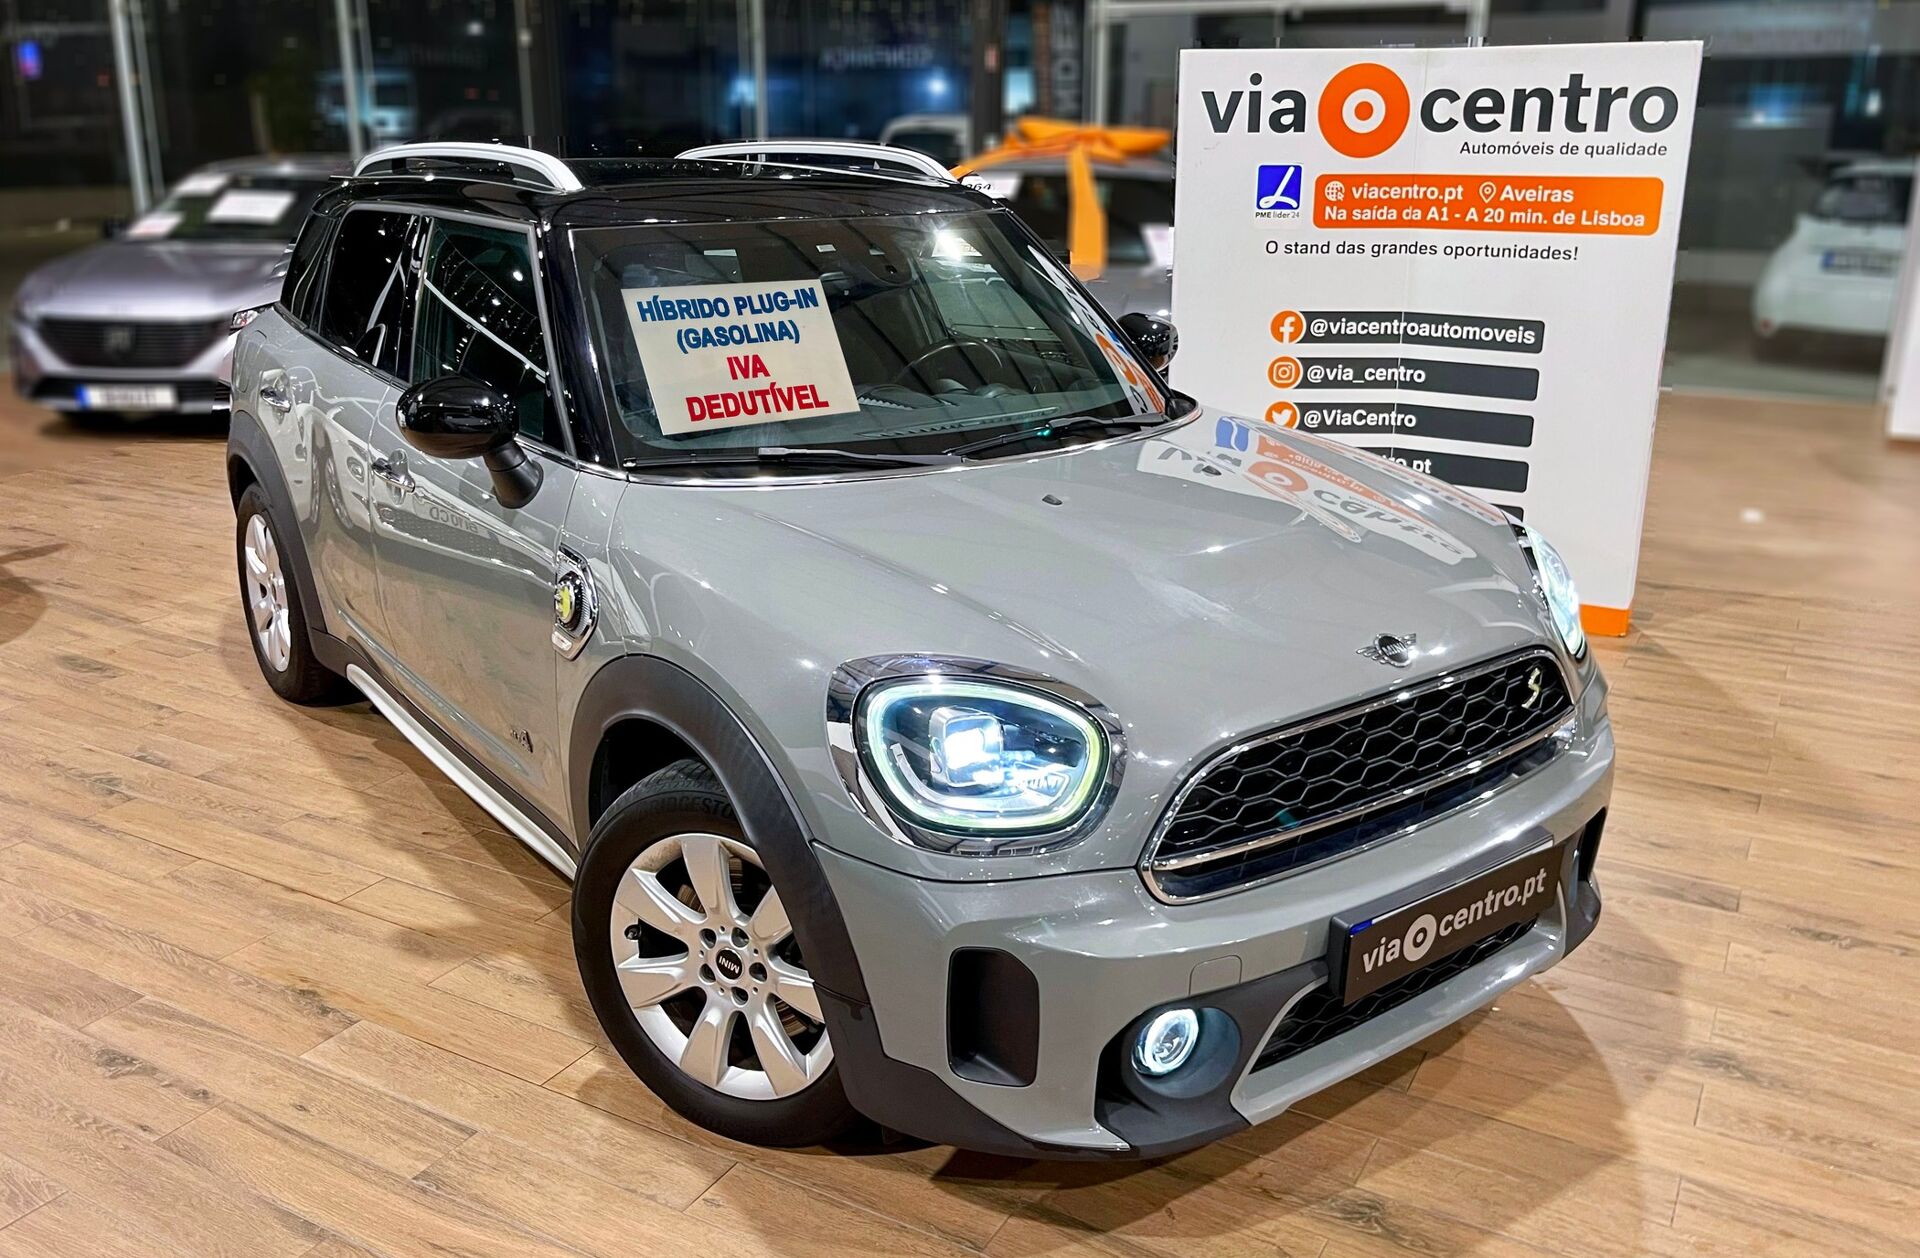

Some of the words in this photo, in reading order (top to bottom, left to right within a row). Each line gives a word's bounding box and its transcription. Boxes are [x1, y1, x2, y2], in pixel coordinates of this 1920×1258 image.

[1420, 73, 1679, 133] centro
[1460, 141, 1554, 156] Automóveis
[1560, 142, 1579, 156] de
[1584, 142, 1667, 159] qualidade
[1351, 183, 1463, 203] viacentro.pt
[1500, 185, 1574, 203] Aveiras
[1255, 211, 1272, 219] PME
[1325, 206, 1347, 220] Na
[1352, 205, 1397, 221] saída
[1402, 206, 1422, 220] da
[1427, 206, 1449, 221] A1
[1465, 207, 1479, 222] A
[1483, 208, 1505, 223] 20
[1509, 209, 1548, 224] min.
[1553, 210, 1575, 225] de
[1581, 210, 1645, 227] Lisboa
[1265, 240, 1279, 254] O
[1284, 240, 1330, 255] stand
[1336, 240, 1365, 255] das
[1371, 241, 1438, 257] grandes
[1443, 244, 1578, 261] oportunidades!
[637, 294, 730, 322] HÍBRIDO
[733, 287, 819, 315] PLUG-IN
[676, 320, 800, 354] (GASOLINA)
[1310, 318, 1536, 344] @viacentroautomoveis
[727, 354, 770, 380] IVA
[1307, 364, 1426, 384] @via_centro
[685, 382, 829, 422] DEDUTÍVEL
[1304, 409, 1417, 428] @ViaCentro
[1362, 937, 1401, 973] via
[1439, 868, 1547, 936] centro.pt
[718, 956, 740, 974] MINI
